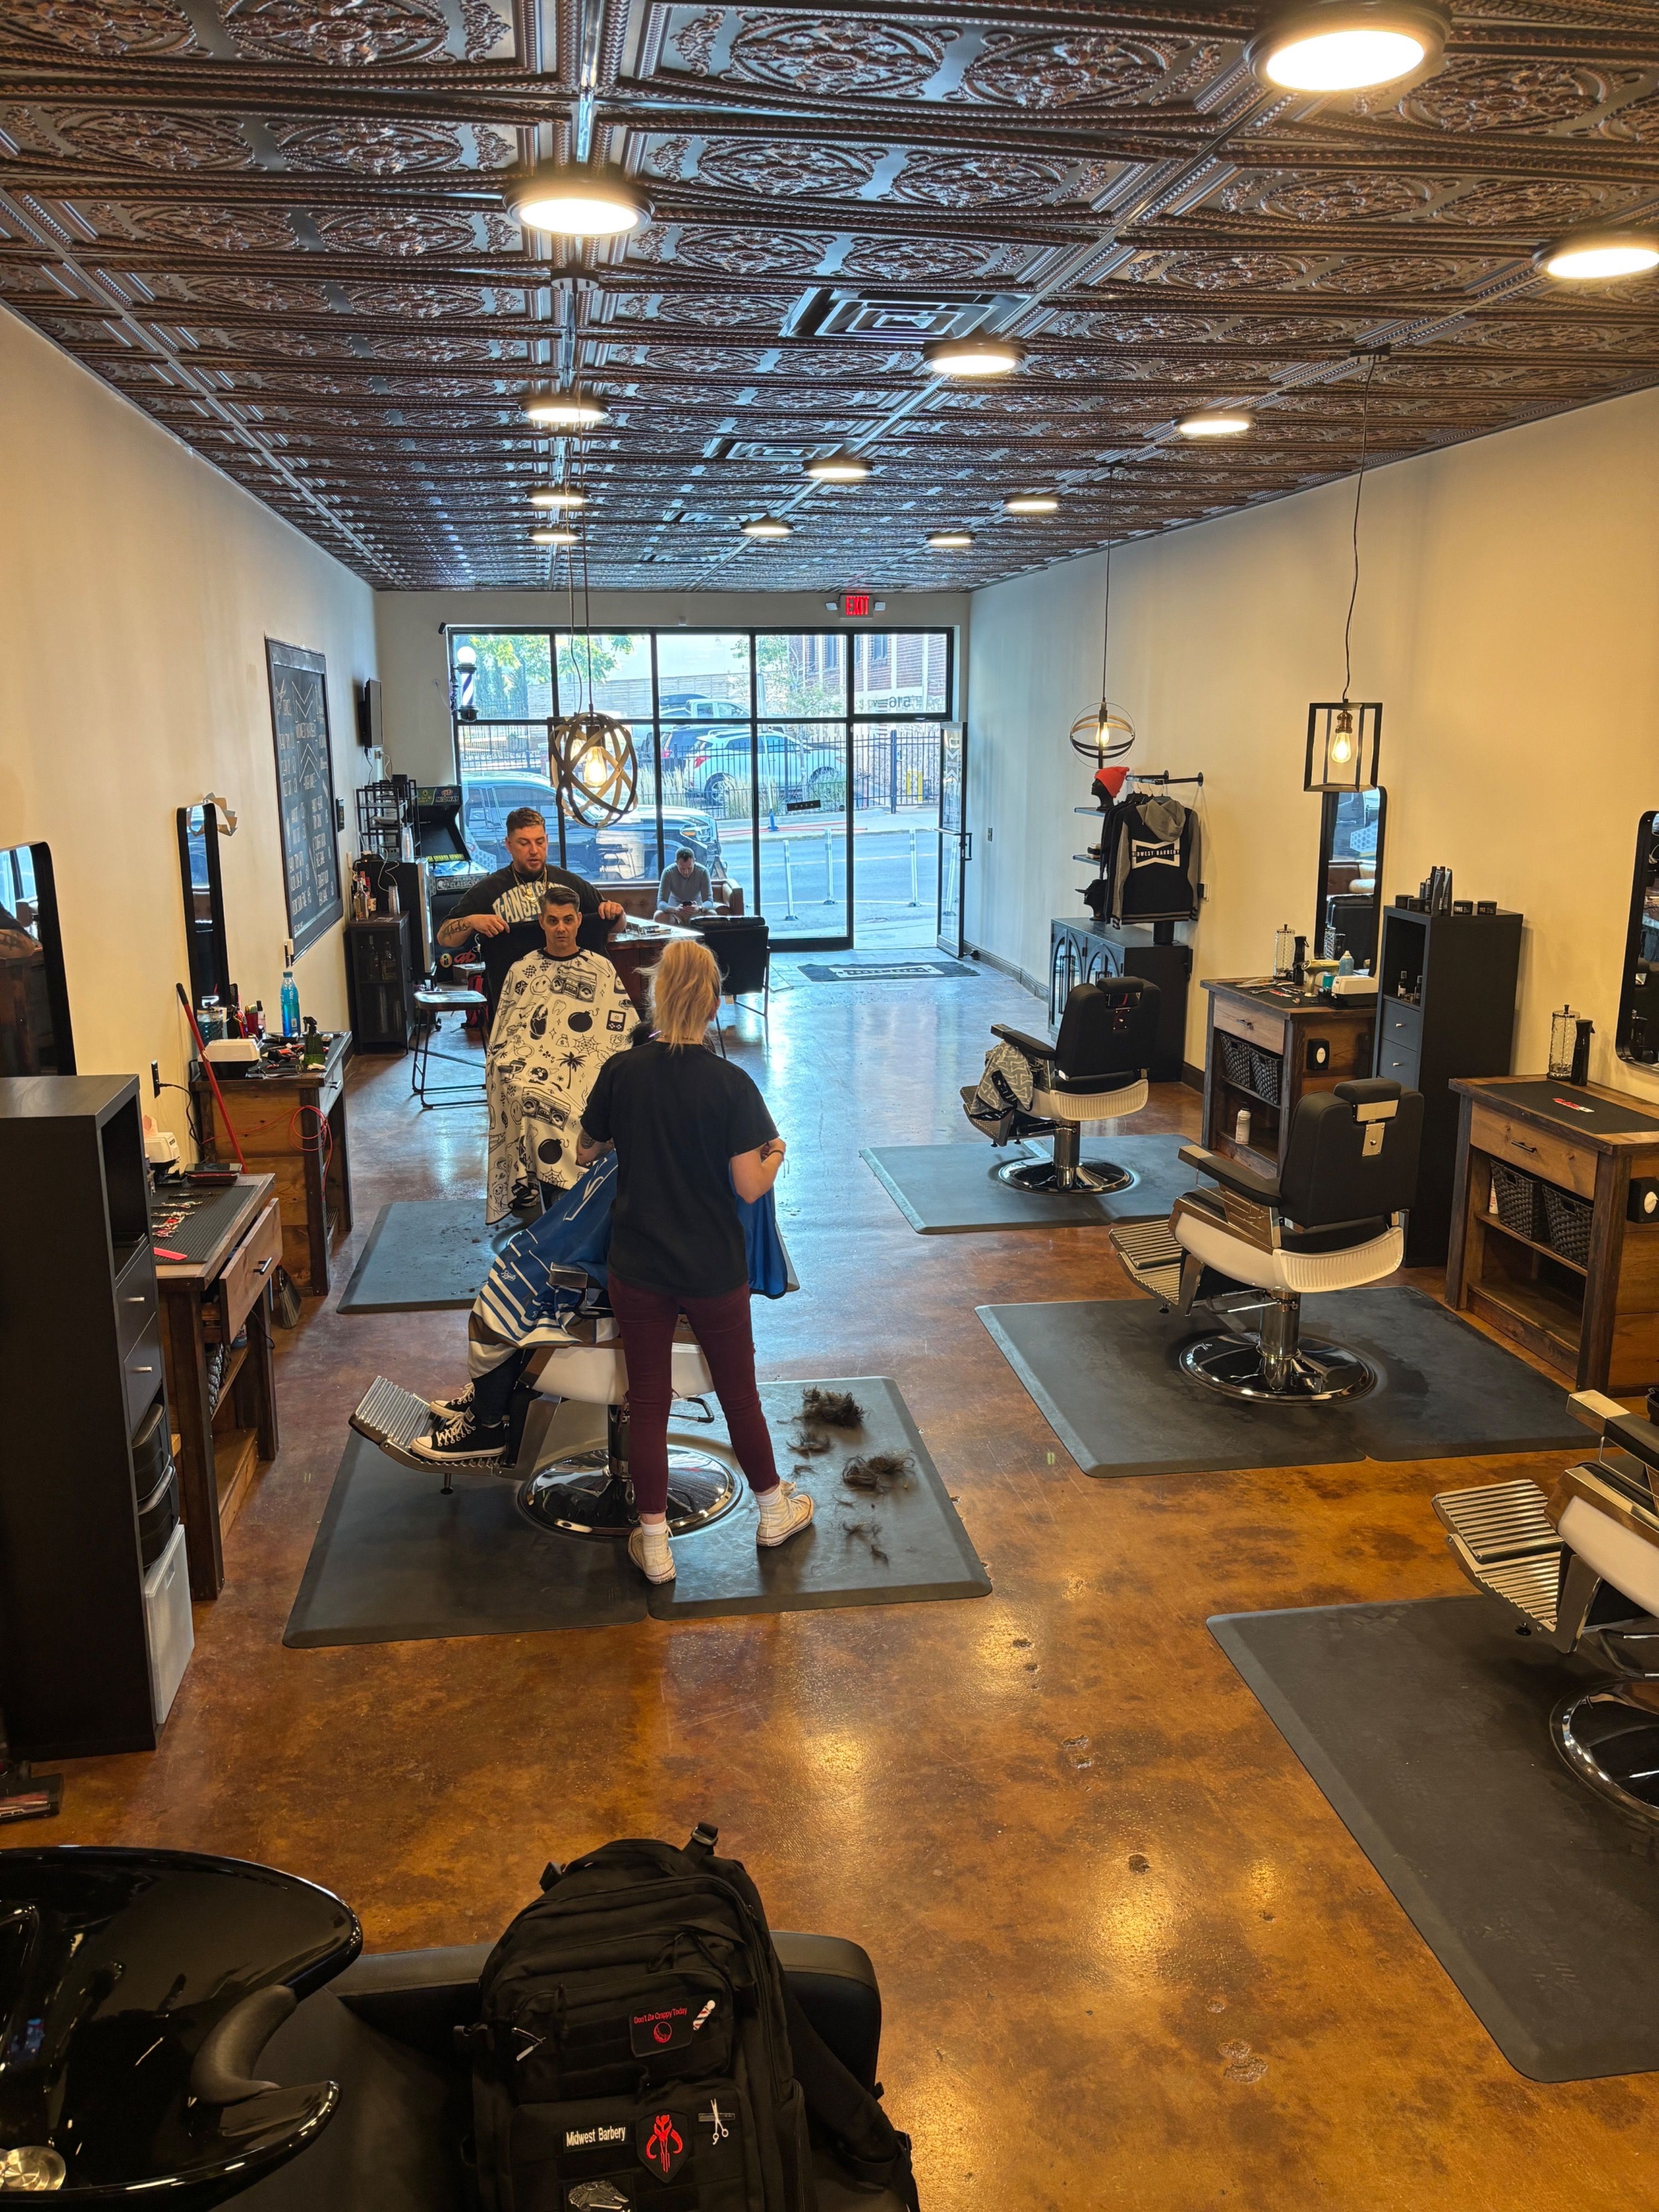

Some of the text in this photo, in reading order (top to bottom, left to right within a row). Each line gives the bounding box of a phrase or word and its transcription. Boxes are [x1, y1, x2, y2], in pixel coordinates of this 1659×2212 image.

[846, 596, 869, 615] EXIT
[655, 2011, 672, 2020] Crappy
[672, 2007, 687, 2016] Today
[566, 2125, 625, 2147] Midwest Barbery
